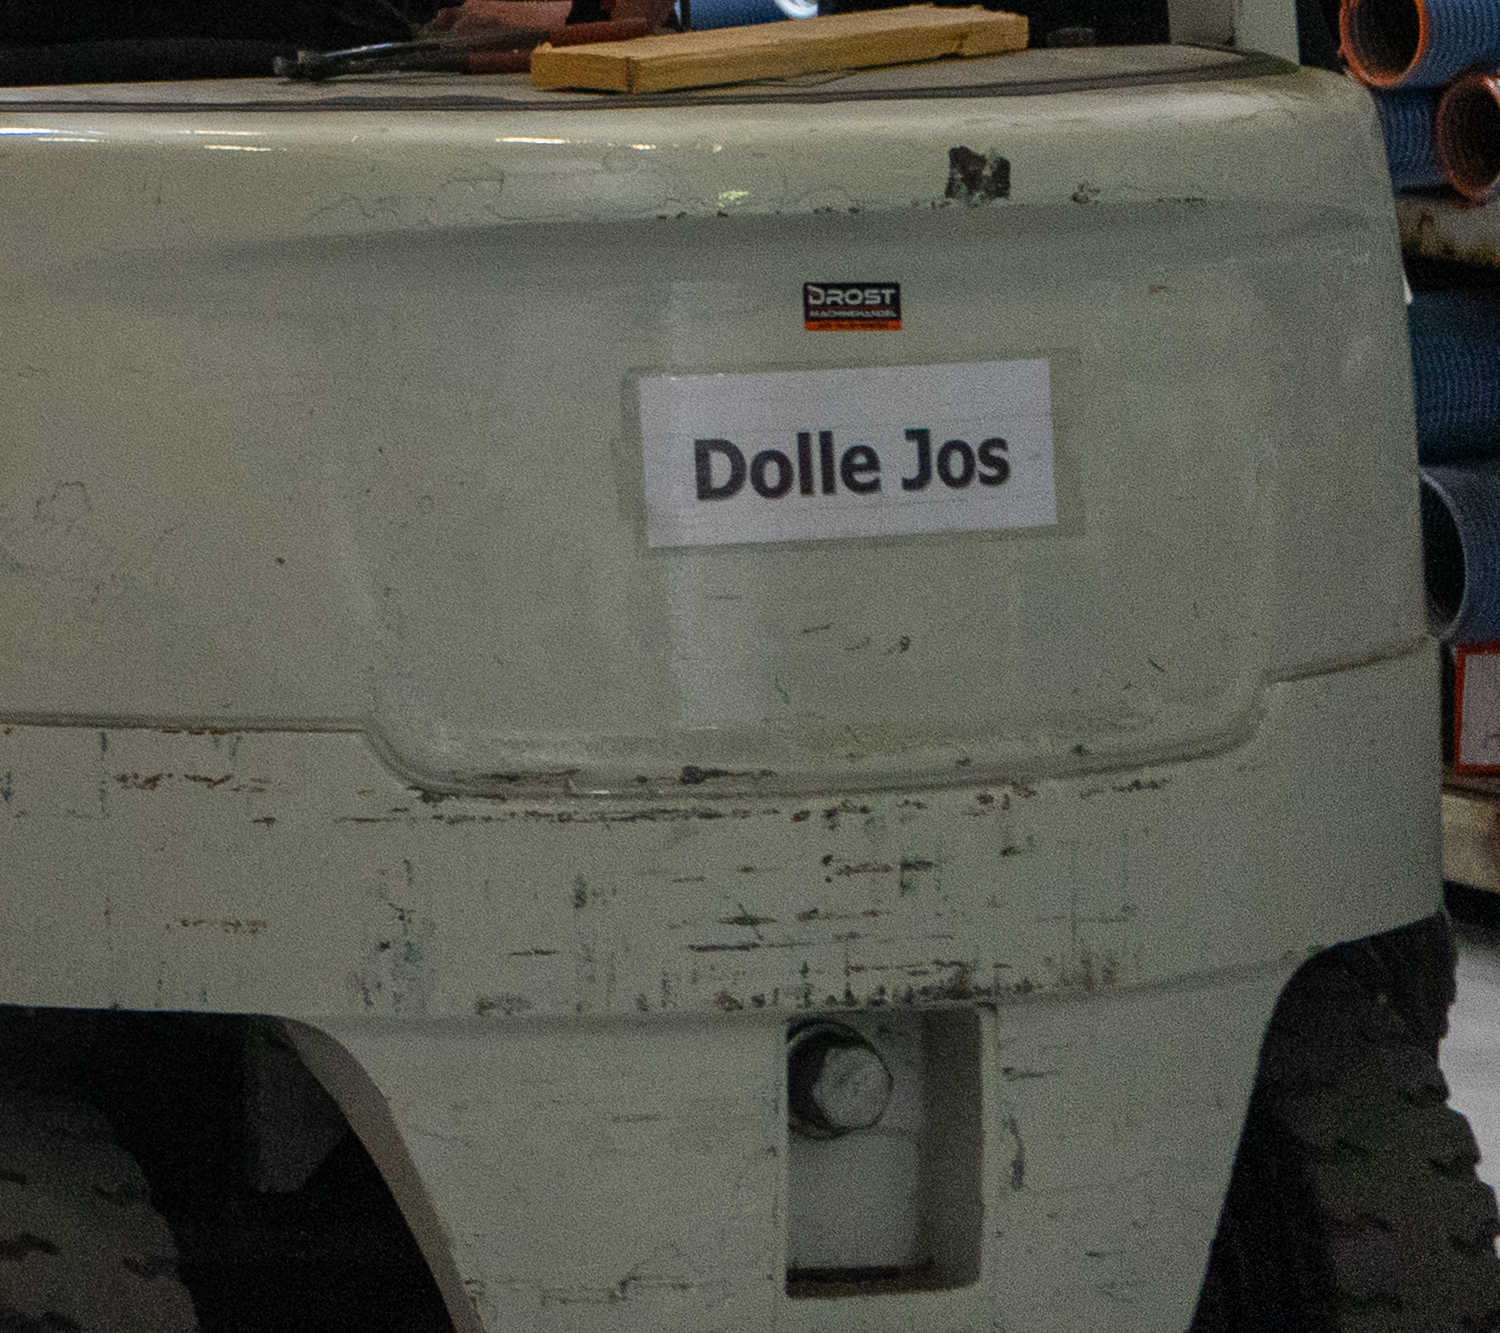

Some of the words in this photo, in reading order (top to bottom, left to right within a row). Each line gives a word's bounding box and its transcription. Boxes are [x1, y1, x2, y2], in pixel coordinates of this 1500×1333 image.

[807, 284, 896, 305] DROST
[693, 430, 883, 502] Dolle
[901, 427, 1011, 493] Jos
